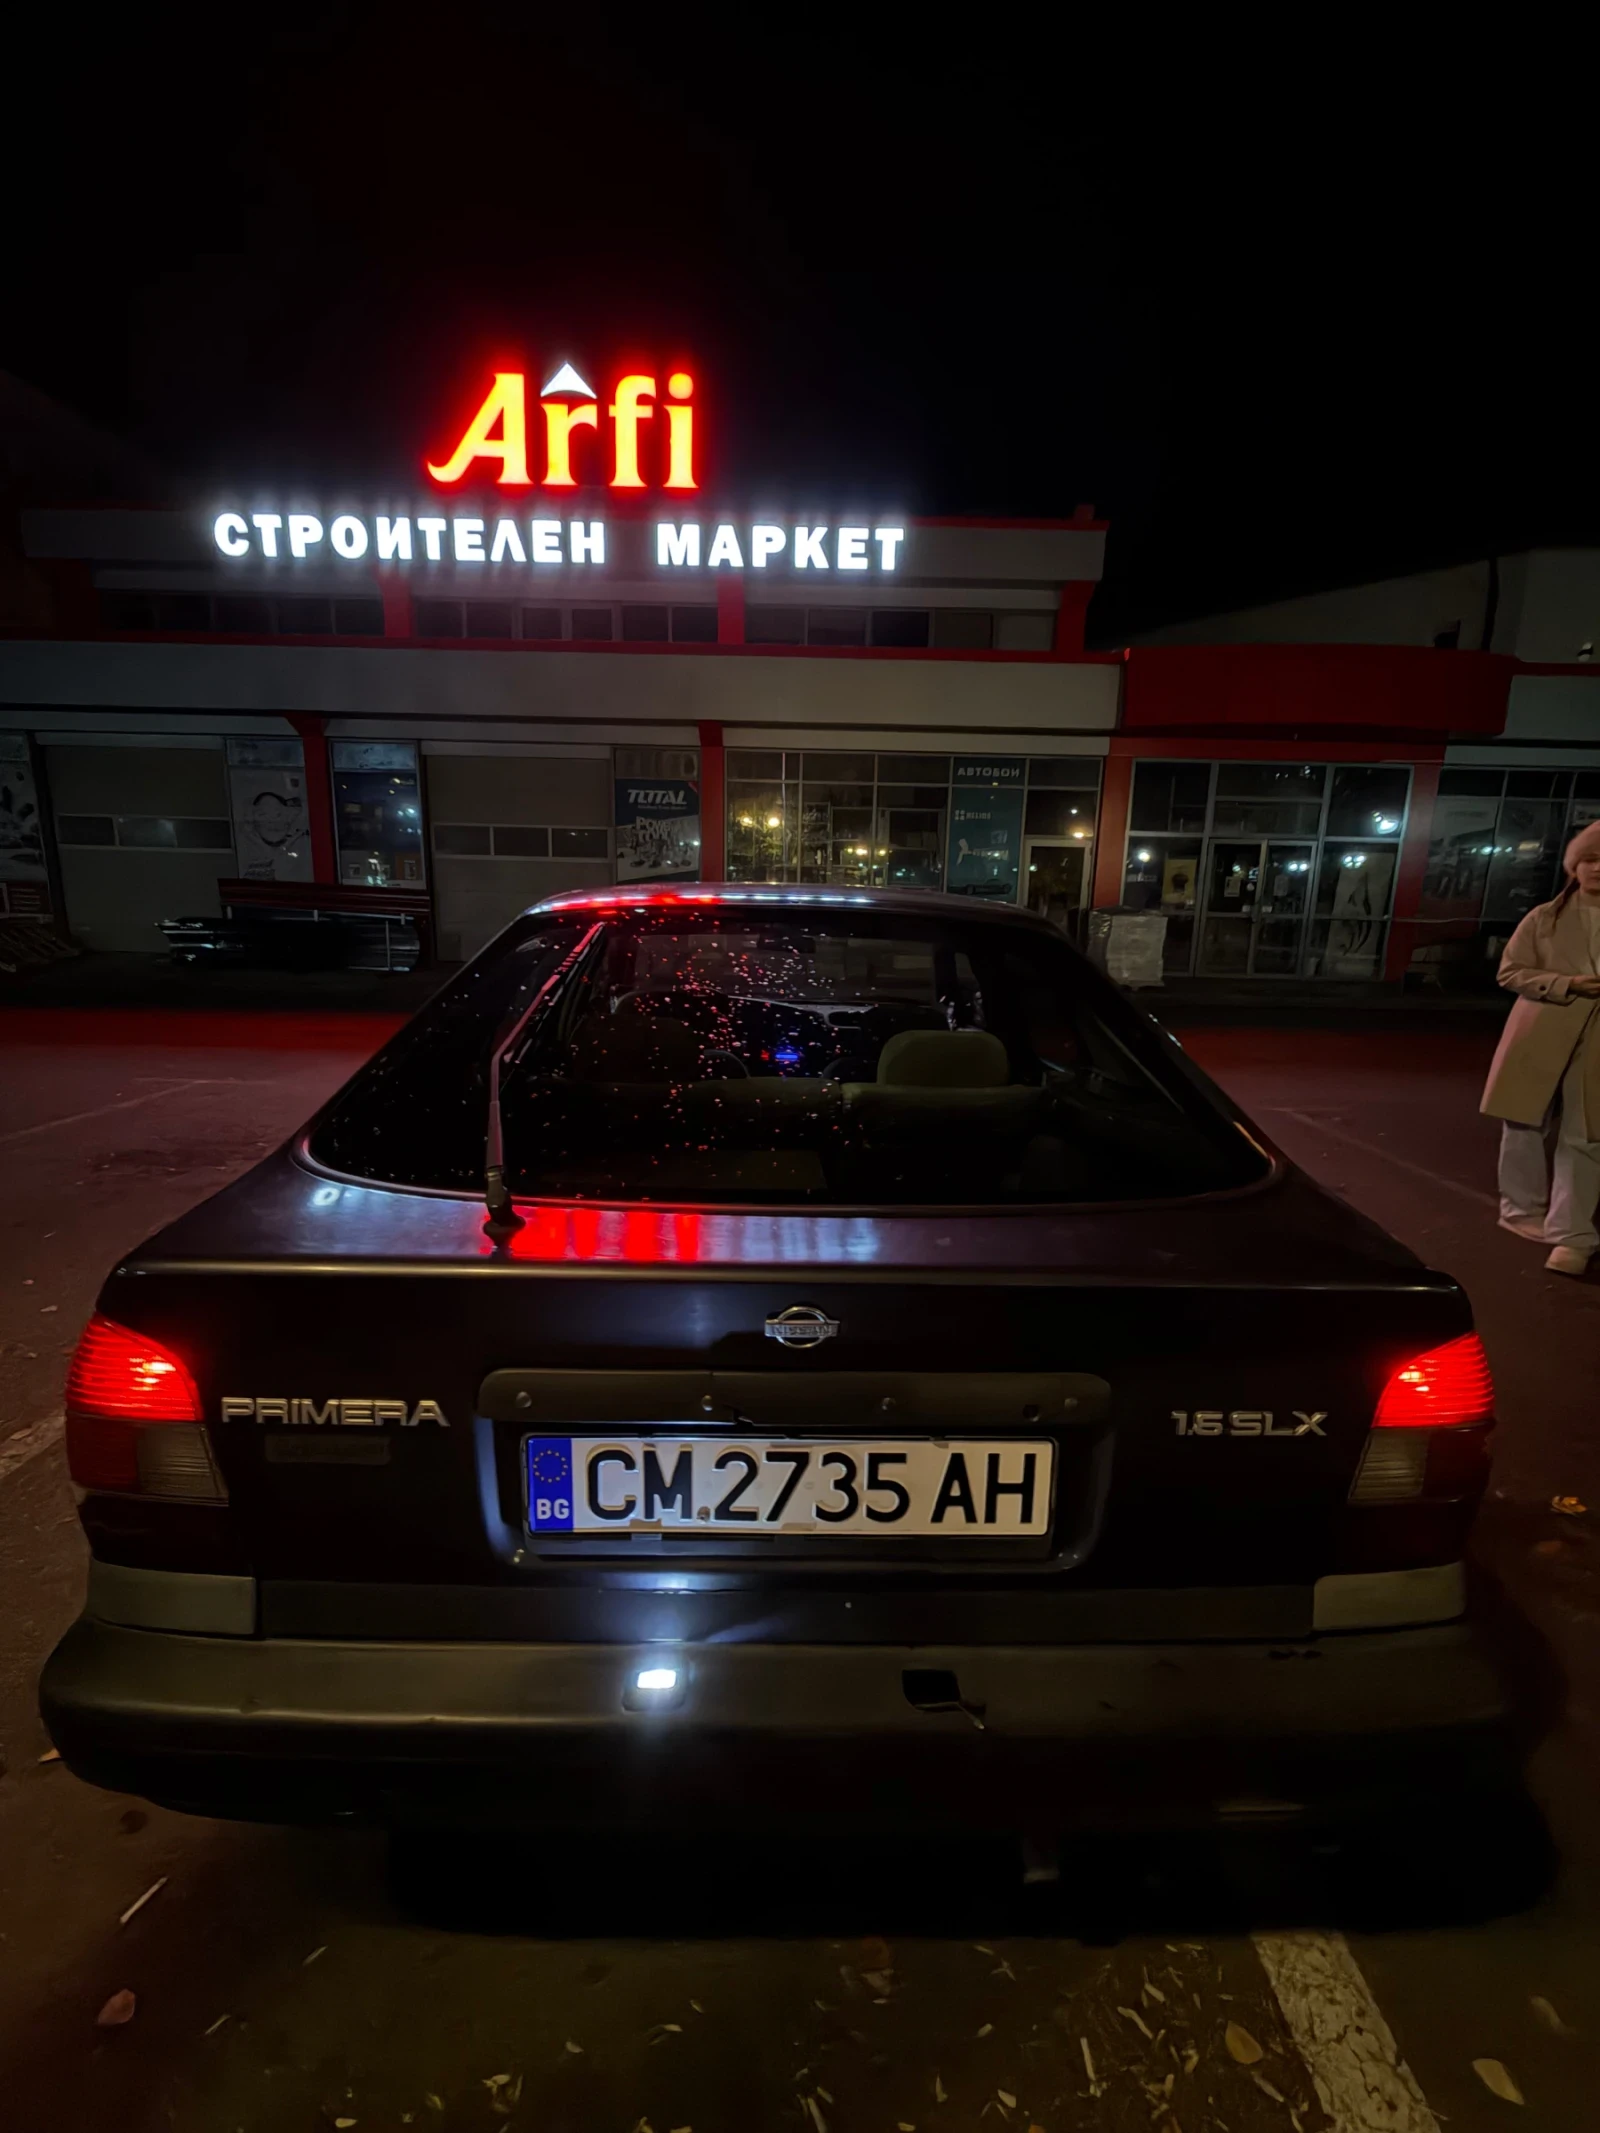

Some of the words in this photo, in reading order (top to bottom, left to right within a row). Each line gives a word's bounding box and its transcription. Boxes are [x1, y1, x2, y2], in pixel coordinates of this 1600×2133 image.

[427, 371, 700, 489] Arfi
[213, 512, 606, 566] СТРОИТЕЛЕН
[656, 523, 905, 572] МАРКЕТ
[627, 788, 688, 804] TOTAL
[220, 1396, 451, 1427] PRIMERA
[1170, 1410, 1224, 1436] 1.6
[1229, 1410, 1329, 1436] SLX
[587, 1447, 693, 1522] CM
[713, 1449, 911, 1523] 2735
[930, 1452, 1037, 1524] AH
[535, 1498, 570, 1521] BG
